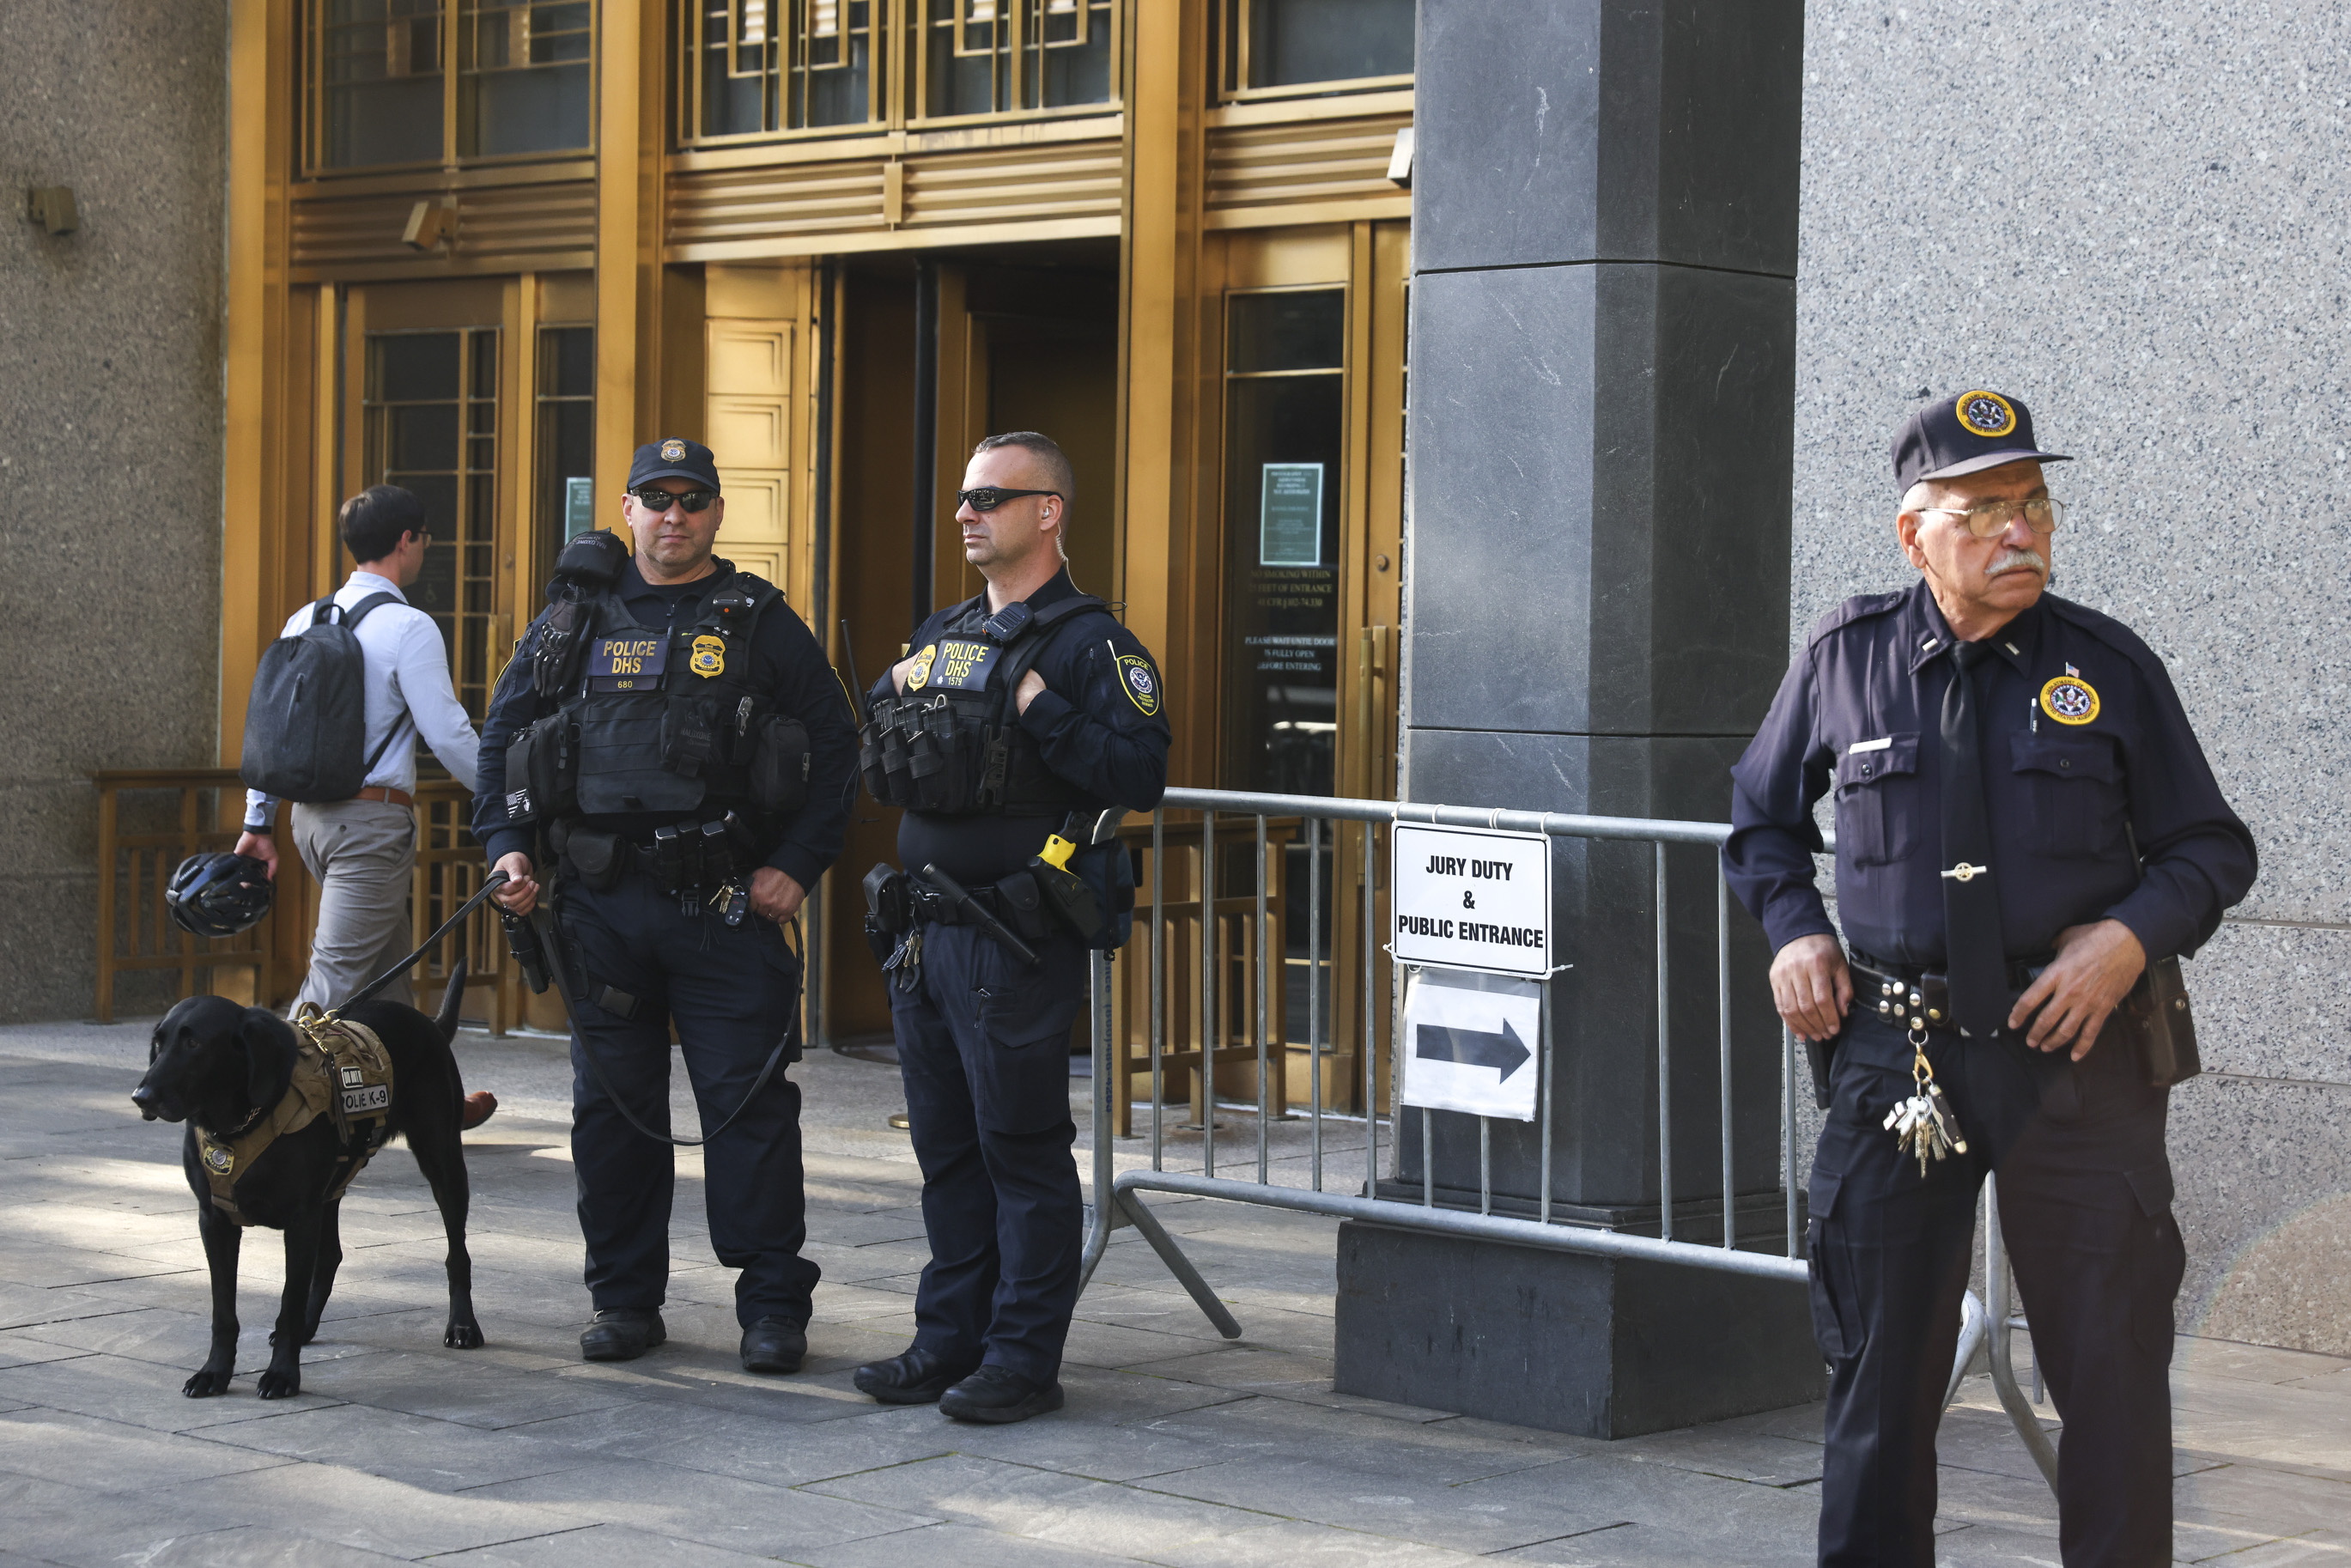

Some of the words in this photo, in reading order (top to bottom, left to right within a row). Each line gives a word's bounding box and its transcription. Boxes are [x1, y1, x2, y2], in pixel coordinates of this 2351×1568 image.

[1290, 584, 1332, 593] ENTRANCE
[604, 641, 657, 657] POLICE
[1245, 636, 1269, 645] PLEASE
[1272, 636, 1290, 645] WAIT
[1291, 637, 1312, 646] UNTIL
[1314, 637, 1335, 646] DOOR
[943, 642, 989, 663] POLICE
[611, 657, 642, 674] DHS
[945, 659, 971, 678] DHS
[1124, 659, 1149, 671] POLICE
[1285, 662, 1321, 671] ENTERING
[948, 677, 963, 686] 1579
[2045, 679, 2075, 696] DEPARTMENT
[2045, 699, 2056, 715] UNITED
[1426, 855, 1467, 877] JURY
[1472, 859, 1513, 881] DUTY
[1462, 890, 1475, 909] &
[1398, 915, 1454, 939] PUBLIC
[1459, 921, 1544, 949] ENTRANCE
[369, 1090, 386, 1105] K-9
